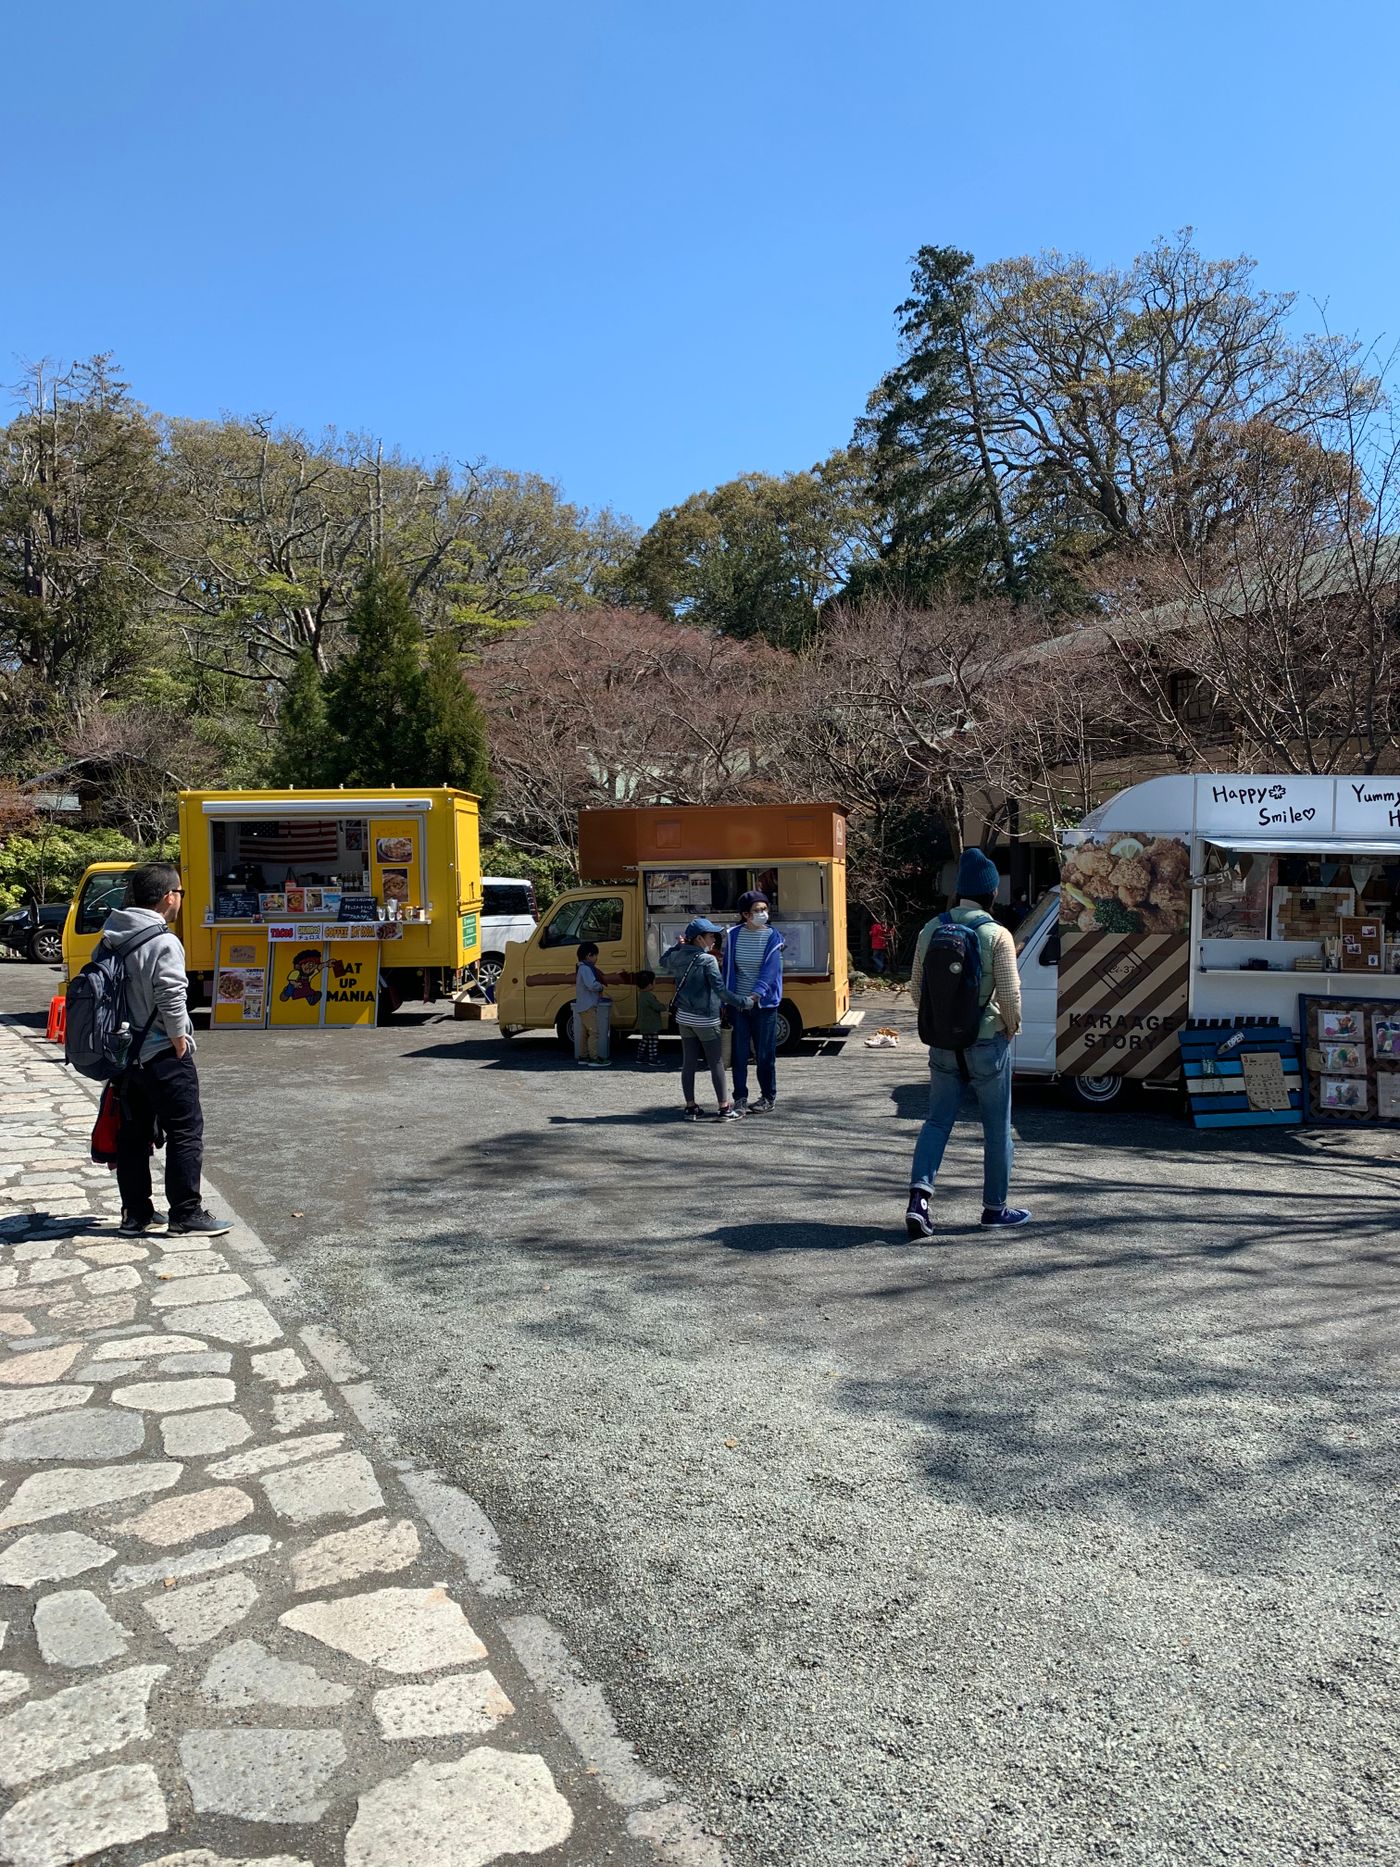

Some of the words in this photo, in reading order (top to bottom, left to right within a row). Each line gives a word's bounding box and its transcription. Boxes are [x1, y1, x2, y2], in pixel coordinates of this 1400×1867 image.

[1212, 785, 1267, 804] Happy
[1258, 806, 1303, 826] Smile
[270, 928, 293, 938] TACOS
[344, 963, 362, 974] AT
[339, 978, 357, 988] UP
[326, 990, 375, 1002] MANIA
[1069, 1013, 1175, 1031] KARAAGE
[1084, 1034, 1157, 1050] STORY
[1227, 1031, 1245, 1048] OPEN
